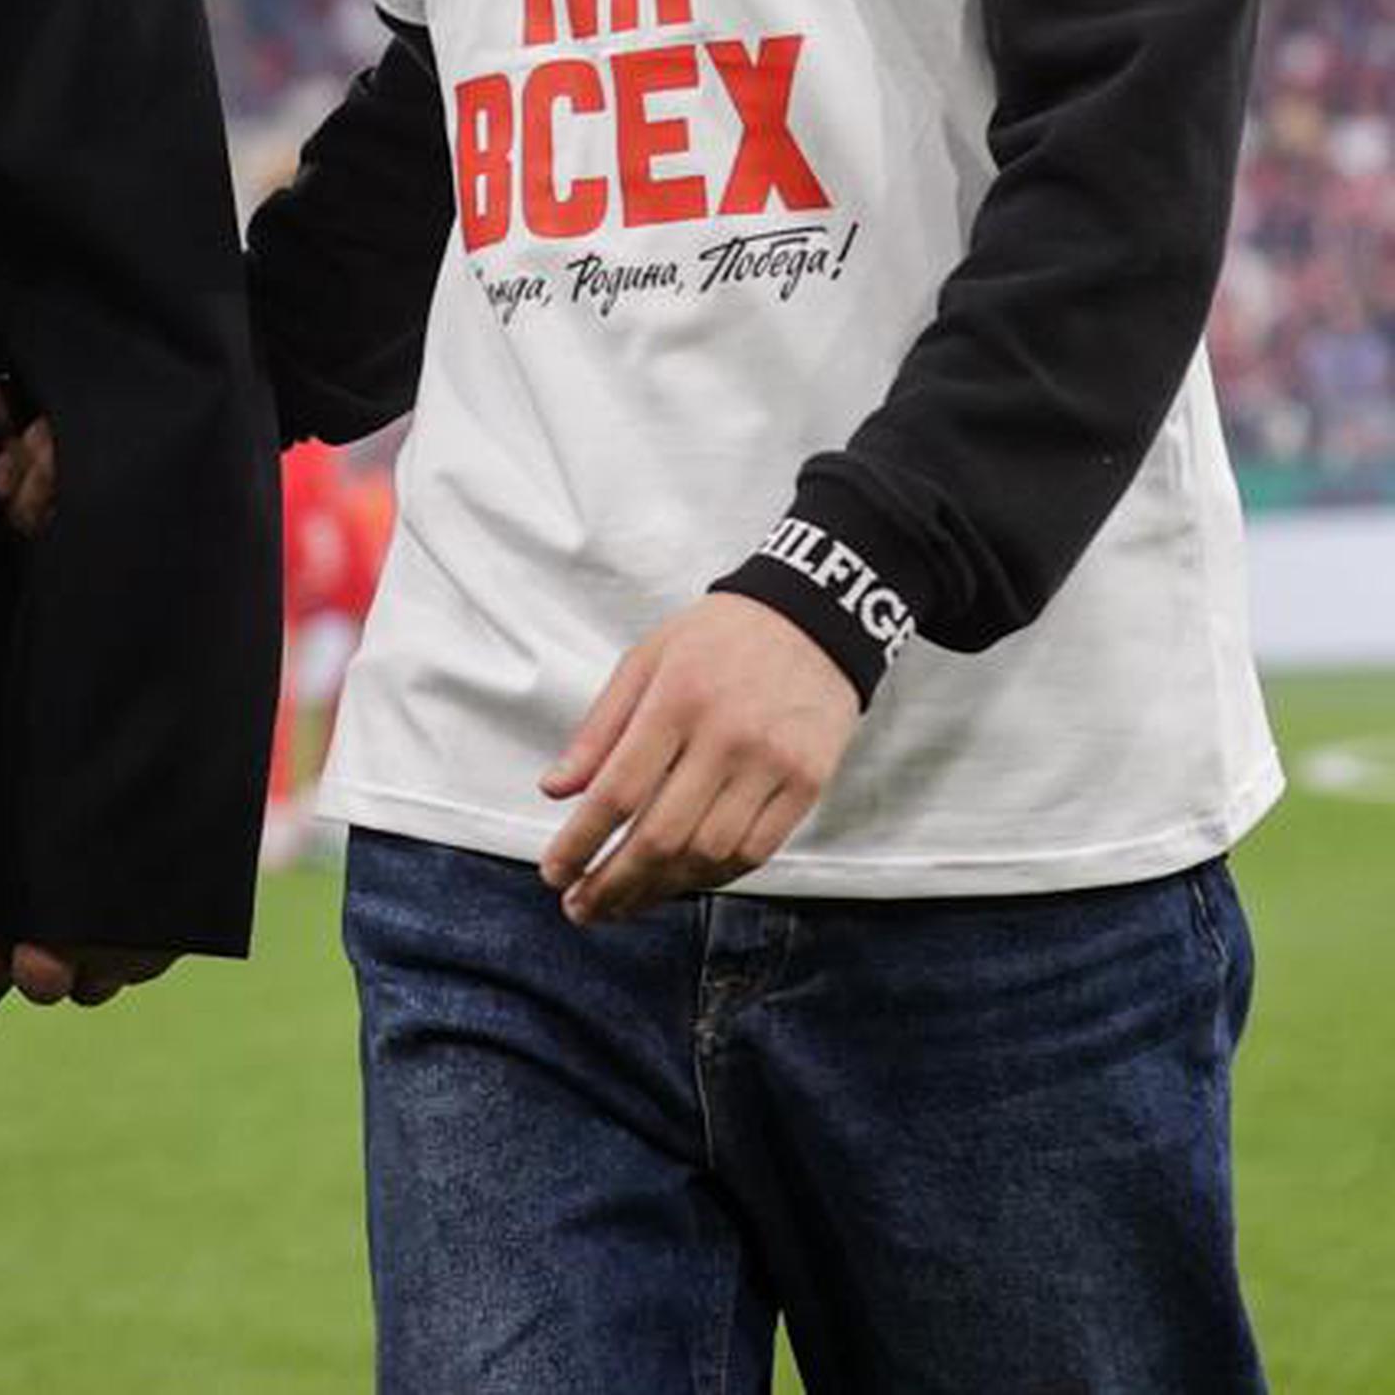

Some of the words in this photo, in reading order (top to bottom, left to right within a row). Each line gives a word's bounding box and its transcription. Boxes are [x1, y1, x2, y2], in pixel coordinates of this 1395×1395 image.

[454, 34, 833, 254] ВСЕХ
[566, 252, 685, 318] Родина,
[698, 221, 860, 302] Победа!
